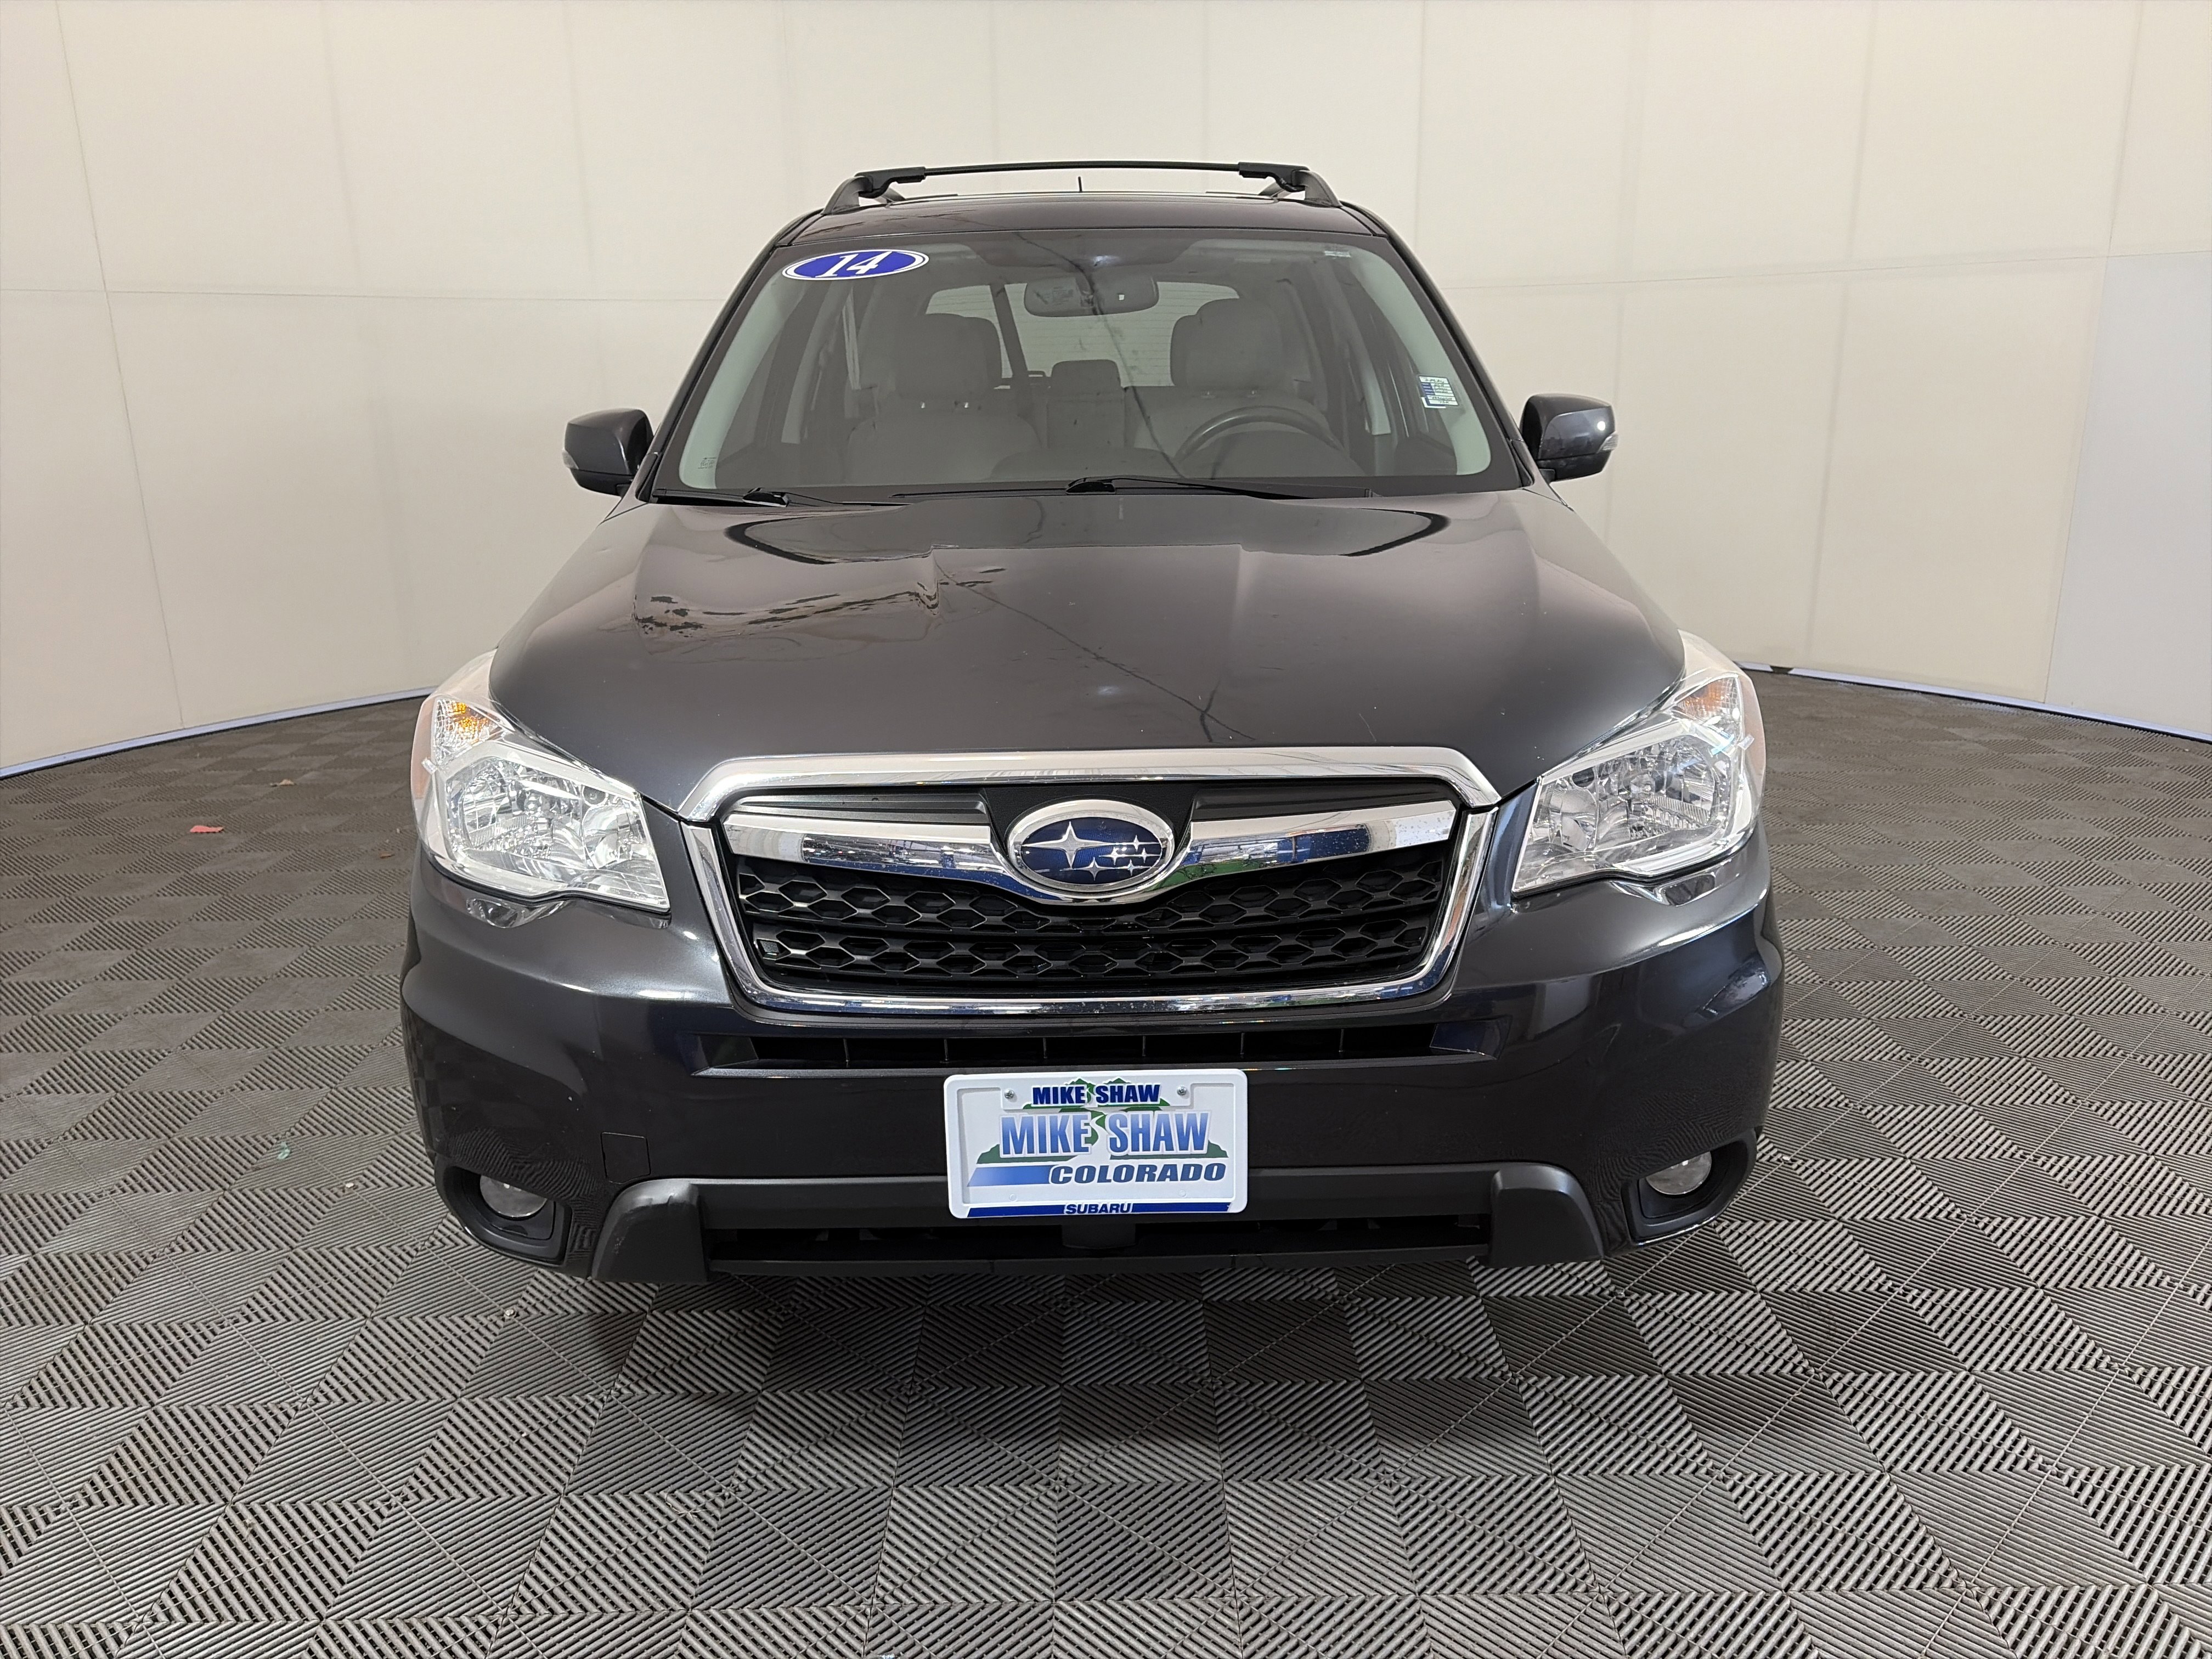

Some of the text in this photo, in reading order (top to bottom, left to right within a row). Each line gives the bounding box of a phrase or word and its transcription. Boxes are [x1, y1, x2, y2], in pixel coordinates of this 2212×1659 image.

[814, 251, 893, 278] 14
[1032, 1084, 1161, 1105] MIKE SHAW
[1001, 1112, 1209, 1155] MIKE SHAW
[1050, 1163, 1227, 1184] COLORADO
[1065, 1203, 1133, 1215] SUBARU
